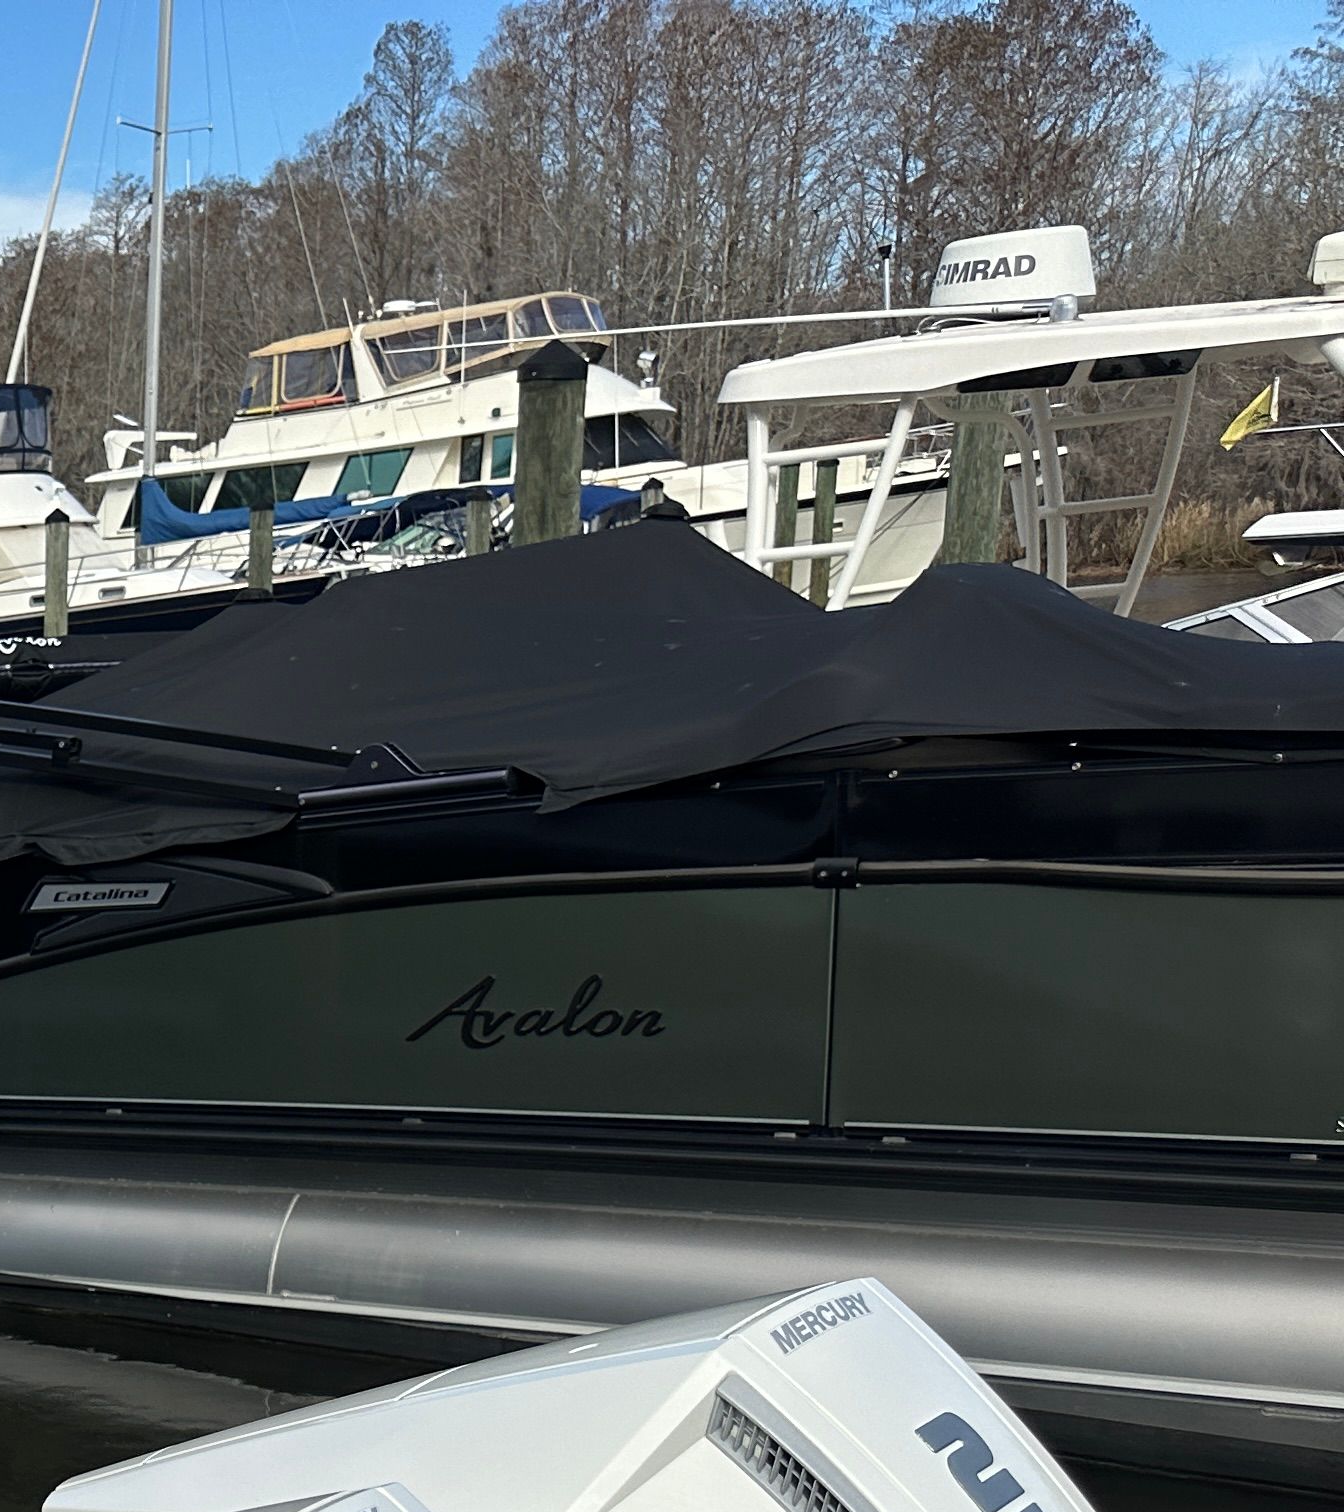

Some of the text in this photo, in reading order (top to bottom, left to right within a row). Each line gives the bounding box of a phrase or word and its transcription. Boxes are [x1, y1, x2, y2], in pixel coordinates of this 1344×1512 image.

[936, 254, 1036, 287] SIMRAD
[53, 888, 149, 903] Catalina
[405, 974, 666, 1049] Avalon
[770, 1292, 872, 1354] MERCURY
